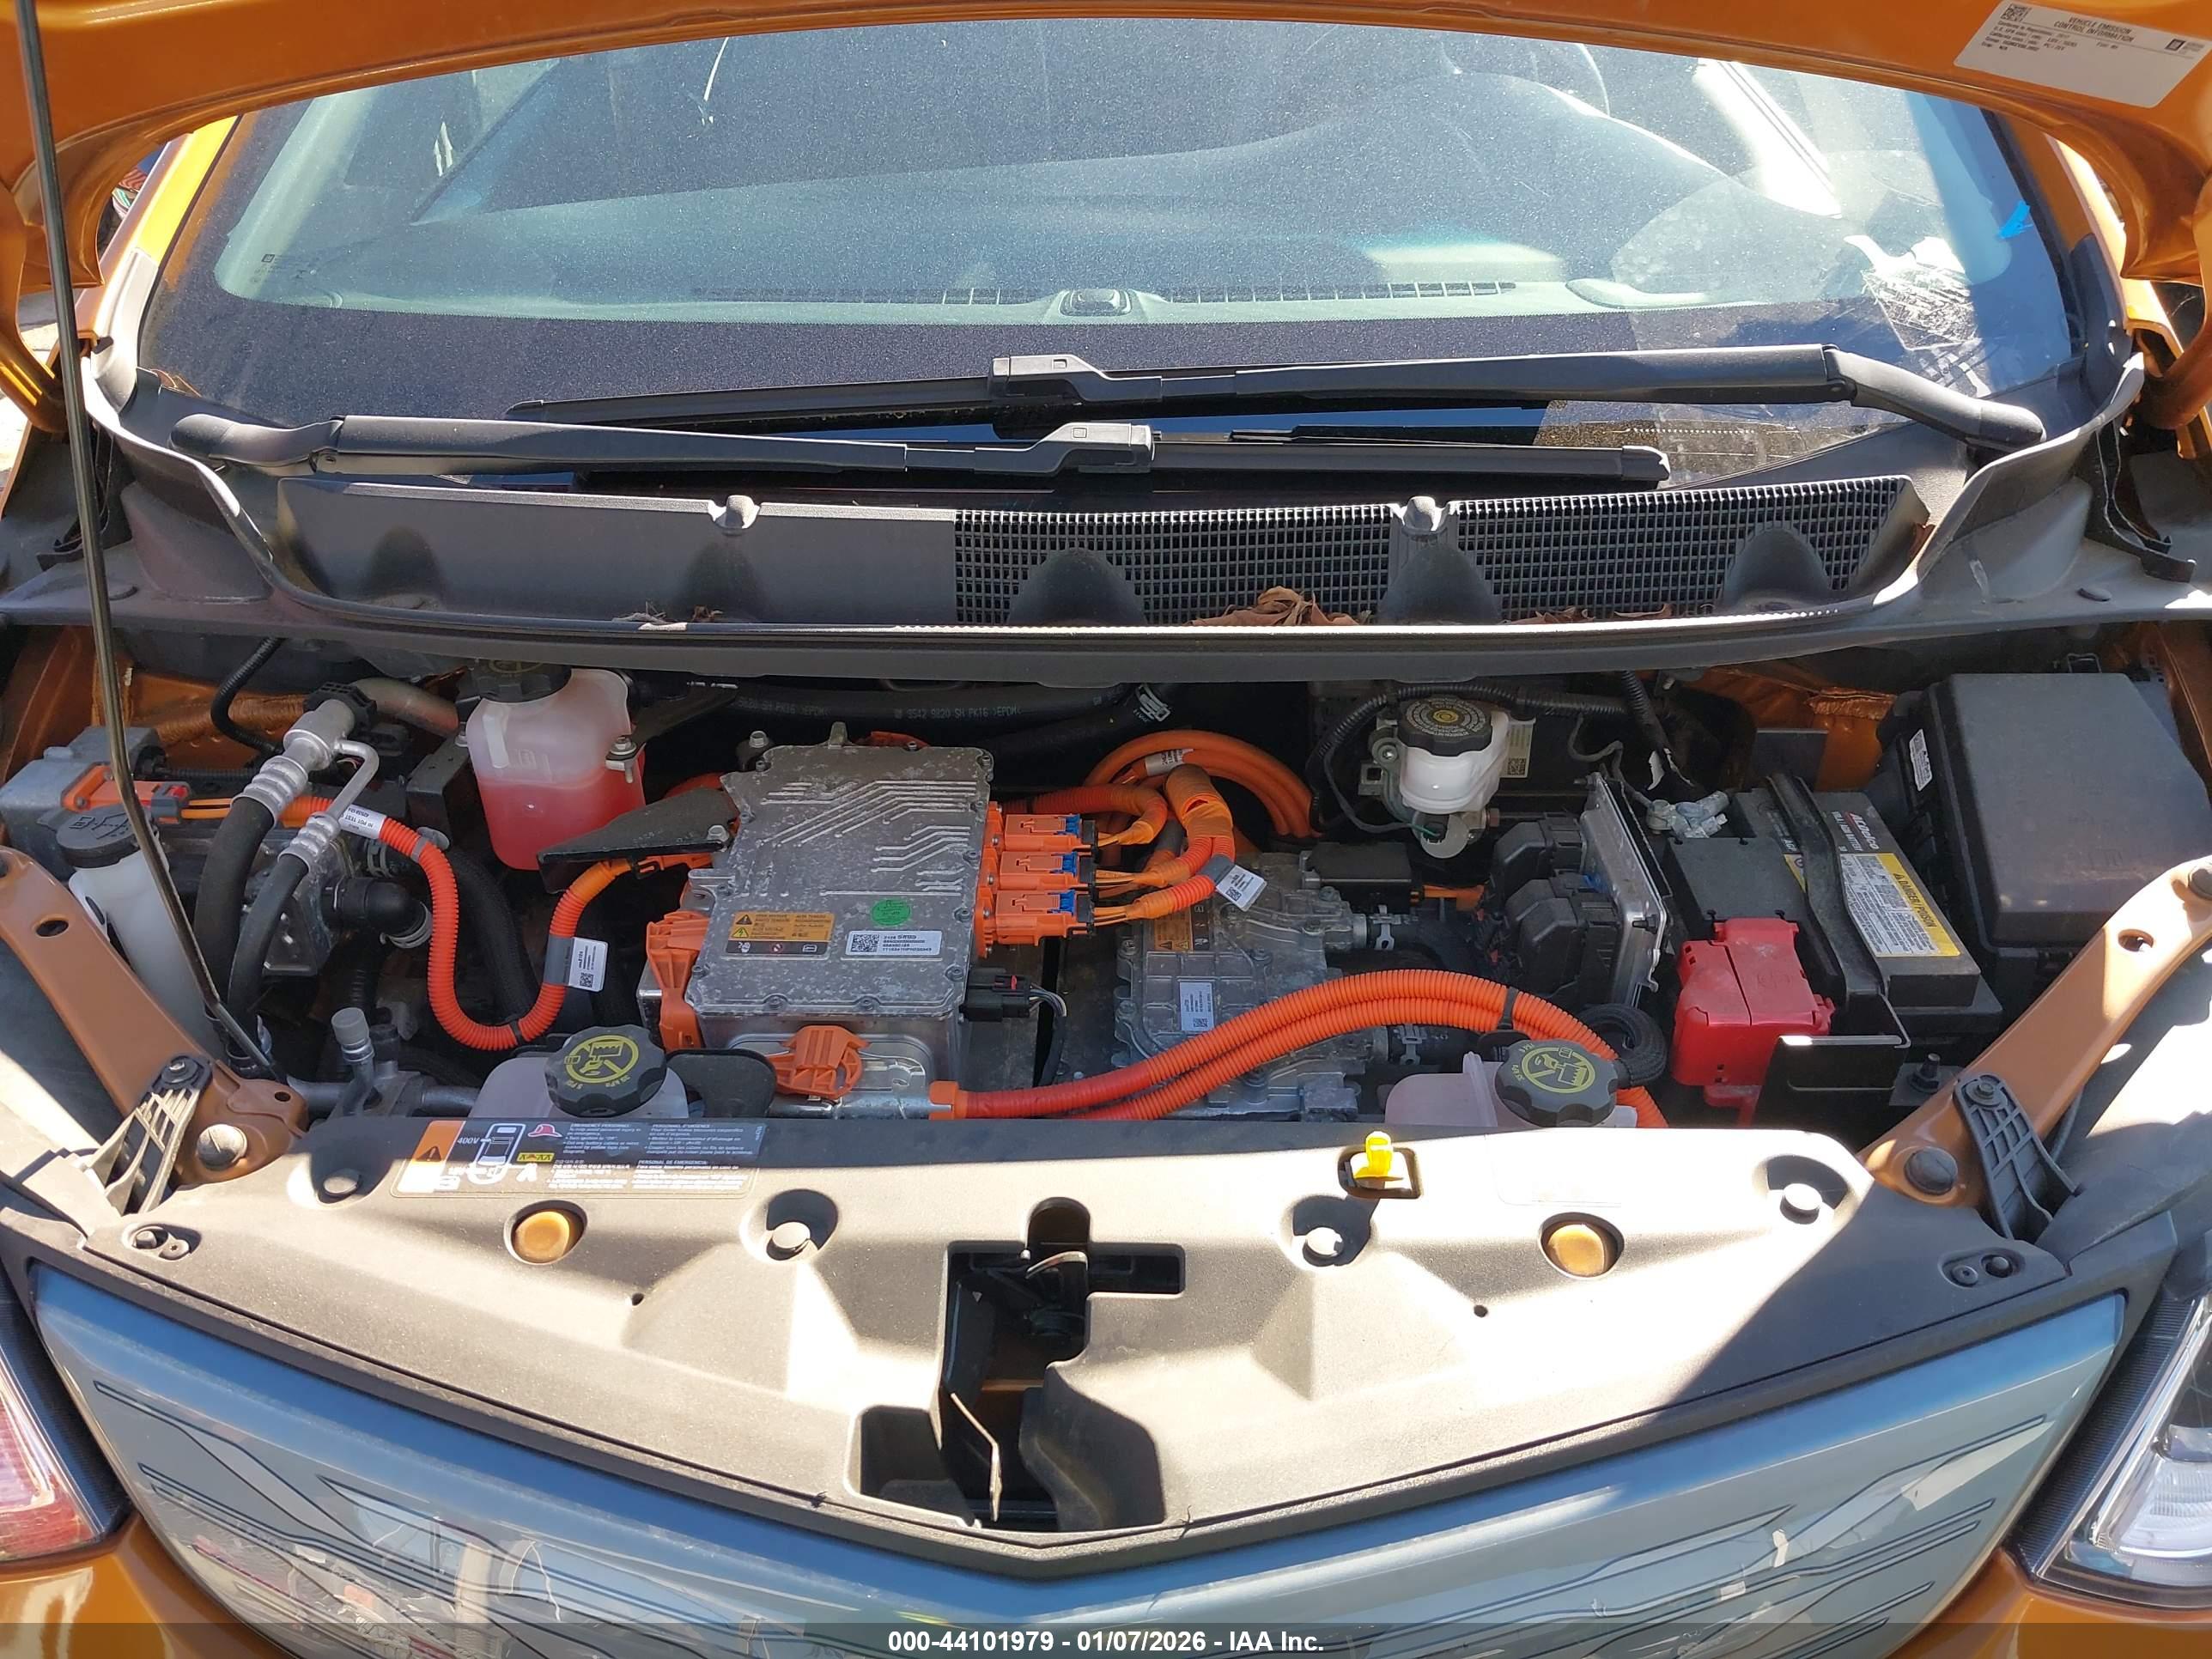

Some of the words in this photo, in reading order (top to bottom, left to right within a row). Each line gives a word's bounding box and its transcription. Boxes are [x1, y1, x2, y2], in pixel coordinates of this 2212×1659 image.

[2053, 21, 2085, 34] CONTROL
[1849, 812, 1880, 850] ACDelco
[1899, 881, 1920, 903] DANGER
[1917, 906, 1937, 927] POISON
